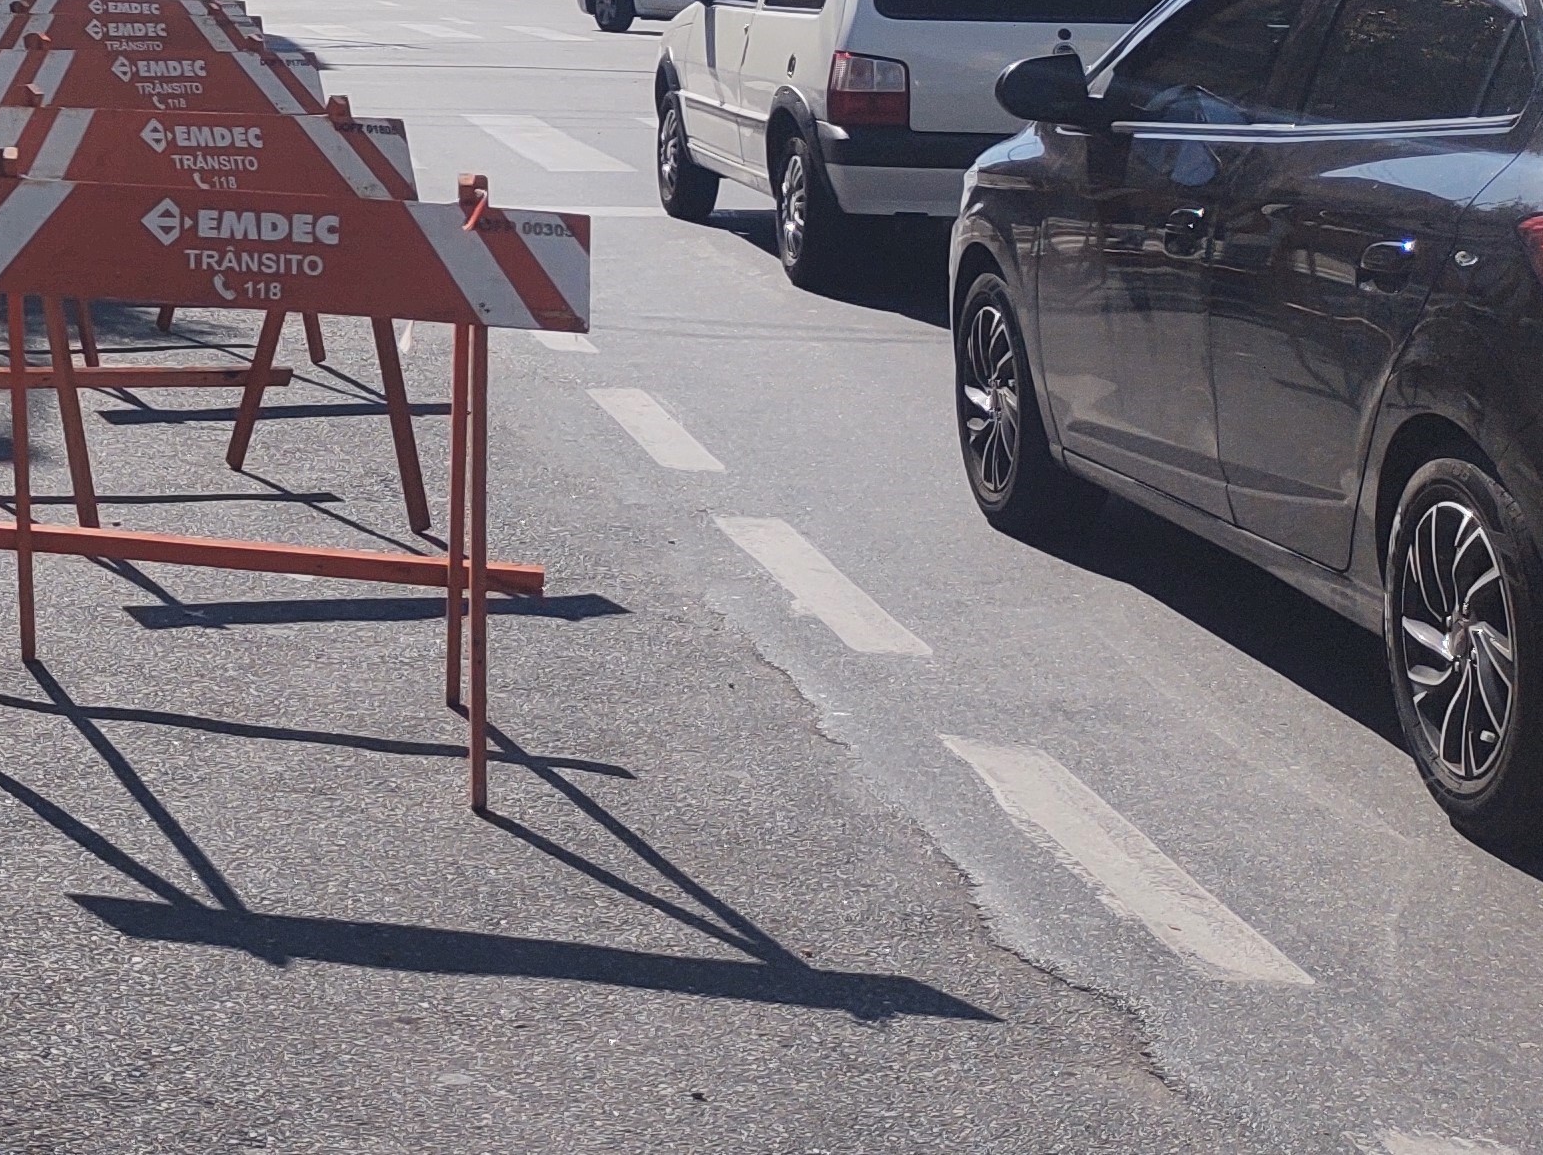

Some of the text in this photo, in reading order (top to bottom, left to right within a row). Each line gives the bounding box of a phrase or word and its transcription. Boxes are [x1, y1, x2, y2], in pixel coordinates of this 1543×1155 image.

[107, 1, 160, 15] EMDEC
[107, 22, 168, 37] EMDEC
[104, 38, 163, 51] TRÂNSITO
[136, 59, 207, 77] EMDEC
[135, 81, 203, 95] TRÂNSITO
[167, 97, 187, 109] 118
[174, 125, 264, 148] EMDEC
[170, 152, 258, 171] TRÂNSITO
[212, 175, 237, 189] 118
[197, 209, 340, 245] EMDEC
[184, 246, 324, 276] TRÂNSITO
[243, 281, 282, 300] 118
